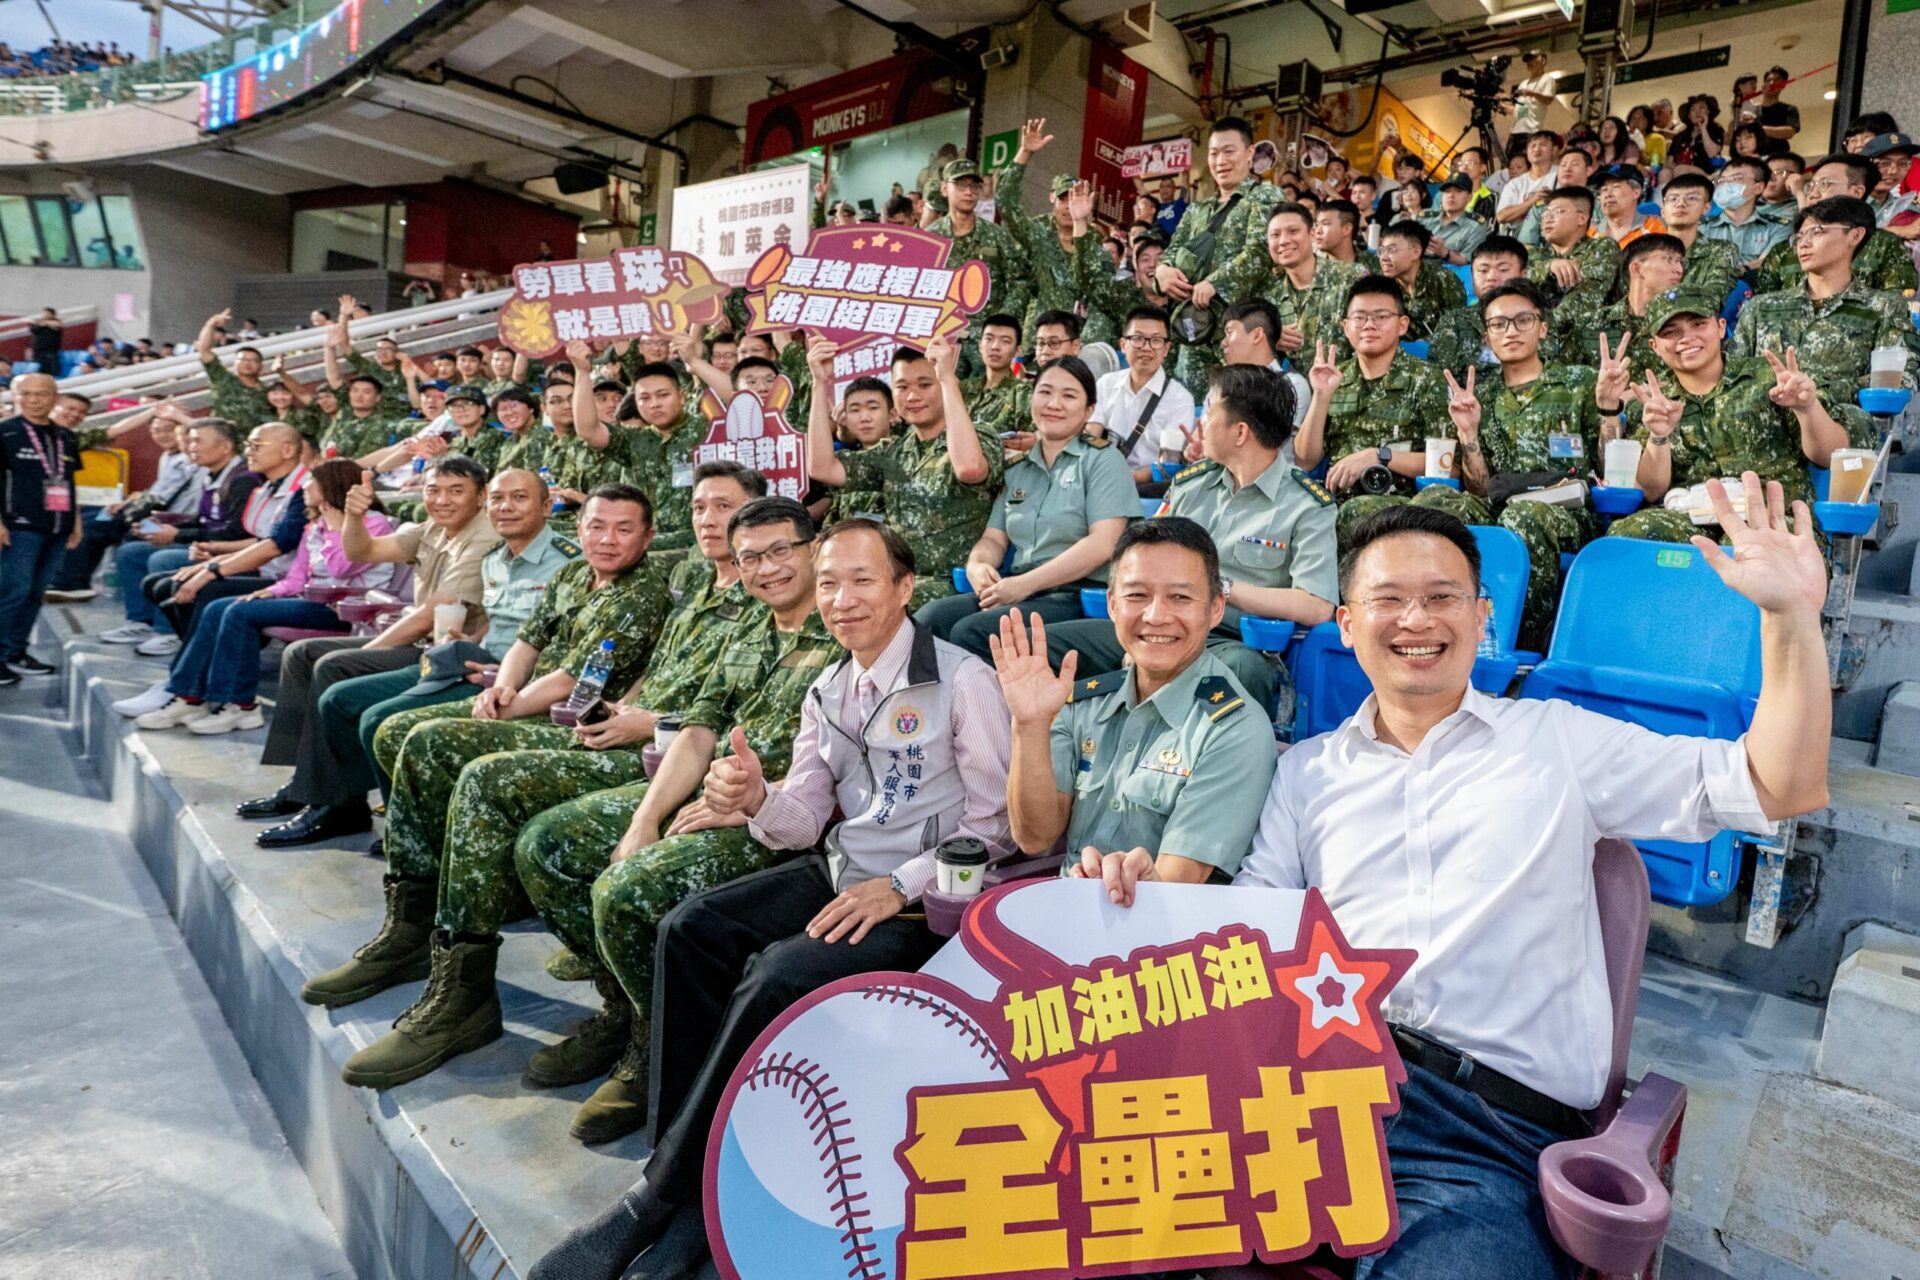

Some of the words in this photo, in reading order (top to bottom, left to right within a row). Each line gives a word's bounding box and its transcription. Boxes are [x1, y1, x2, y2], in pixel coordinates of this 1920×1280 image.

[812, 104, 866, 138] MONKEYS
[992, 141, 1008, 167] D
[644, 219, 653, 237] C
[719, 223, 791, 257] 加菜金
[781, 255, 955, 301] 最強應援團
[767, 291, 941, 338] 桃園挺國軍
[1664, 551, 1684, 567] 15
[904, 744, 925, 802] 桃園市
[1003, 935, 1273, 1062] 加油加油
[903, 1064, 1392, 1280] 全壘打
